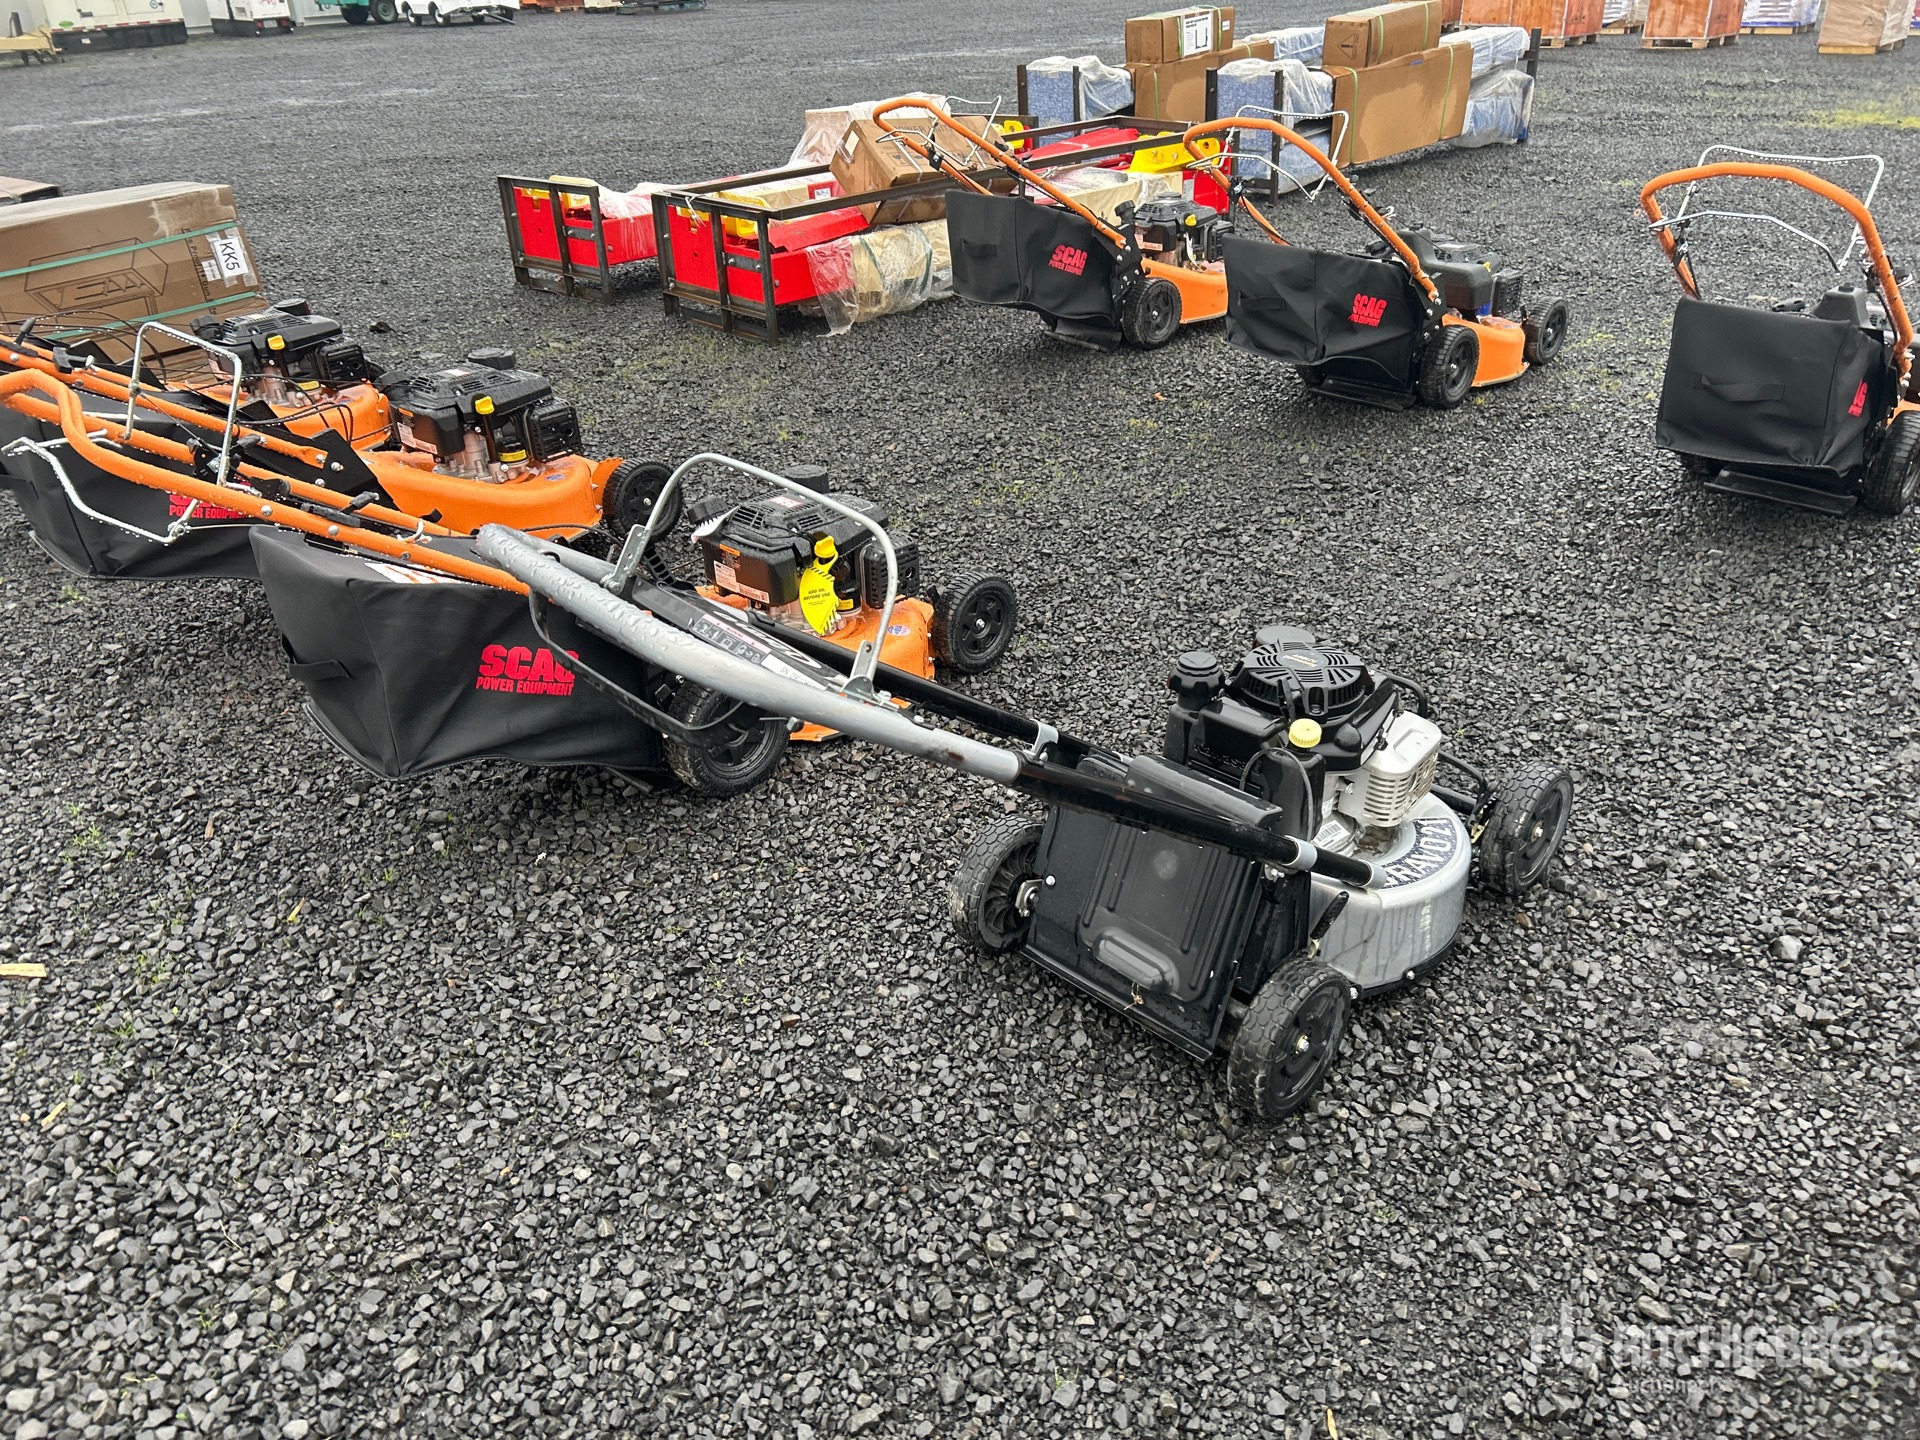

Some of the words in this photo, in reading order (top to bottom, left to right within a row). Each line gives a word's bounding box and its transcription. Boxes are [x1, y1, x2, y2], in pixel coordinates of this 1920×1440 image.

[219, 241, 240, 271] KK5
[190, 246, 203, 268] Proof
[202, 280, 211, 297] Gun
[1352, 293, 1388, 319] SCAG
[169, 504, 204, 518] POER
[475, 676, 515, 693] POWER
[516, 680, 575, 696] EQUIPMENT
